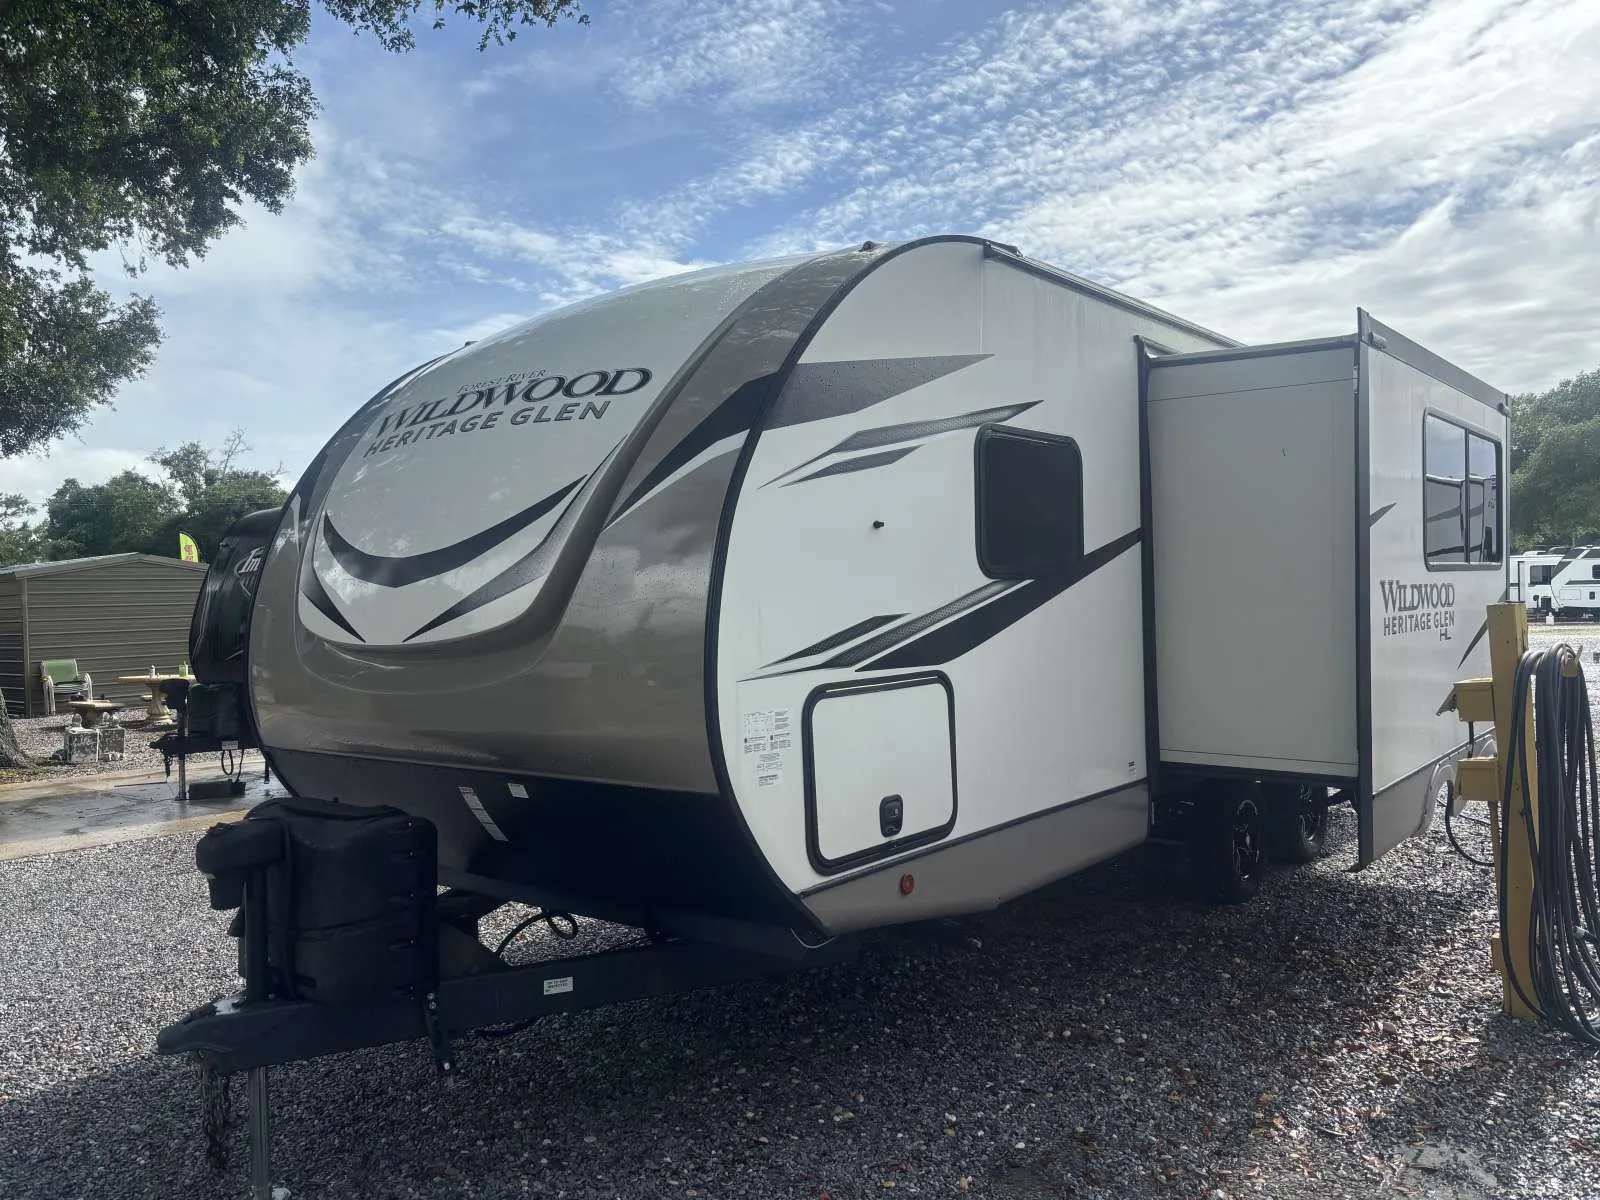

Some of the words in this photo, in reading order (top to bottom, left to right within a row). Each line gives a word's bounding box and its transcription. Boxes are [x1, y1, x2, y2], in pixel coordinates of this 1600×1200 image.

[505, 369, 546, 384] RIVER
[375, 367, 652, 438] WILDWOOD
[363, 411, 503, 458] HERITAGE
[510, 400, 611, 426] GLEN
[1379, 579, 1455, 613] WILDWOOD
[1383, 613, 1431, 636] HERITAGE
[1433, 611, 1455, 628] GLEN
